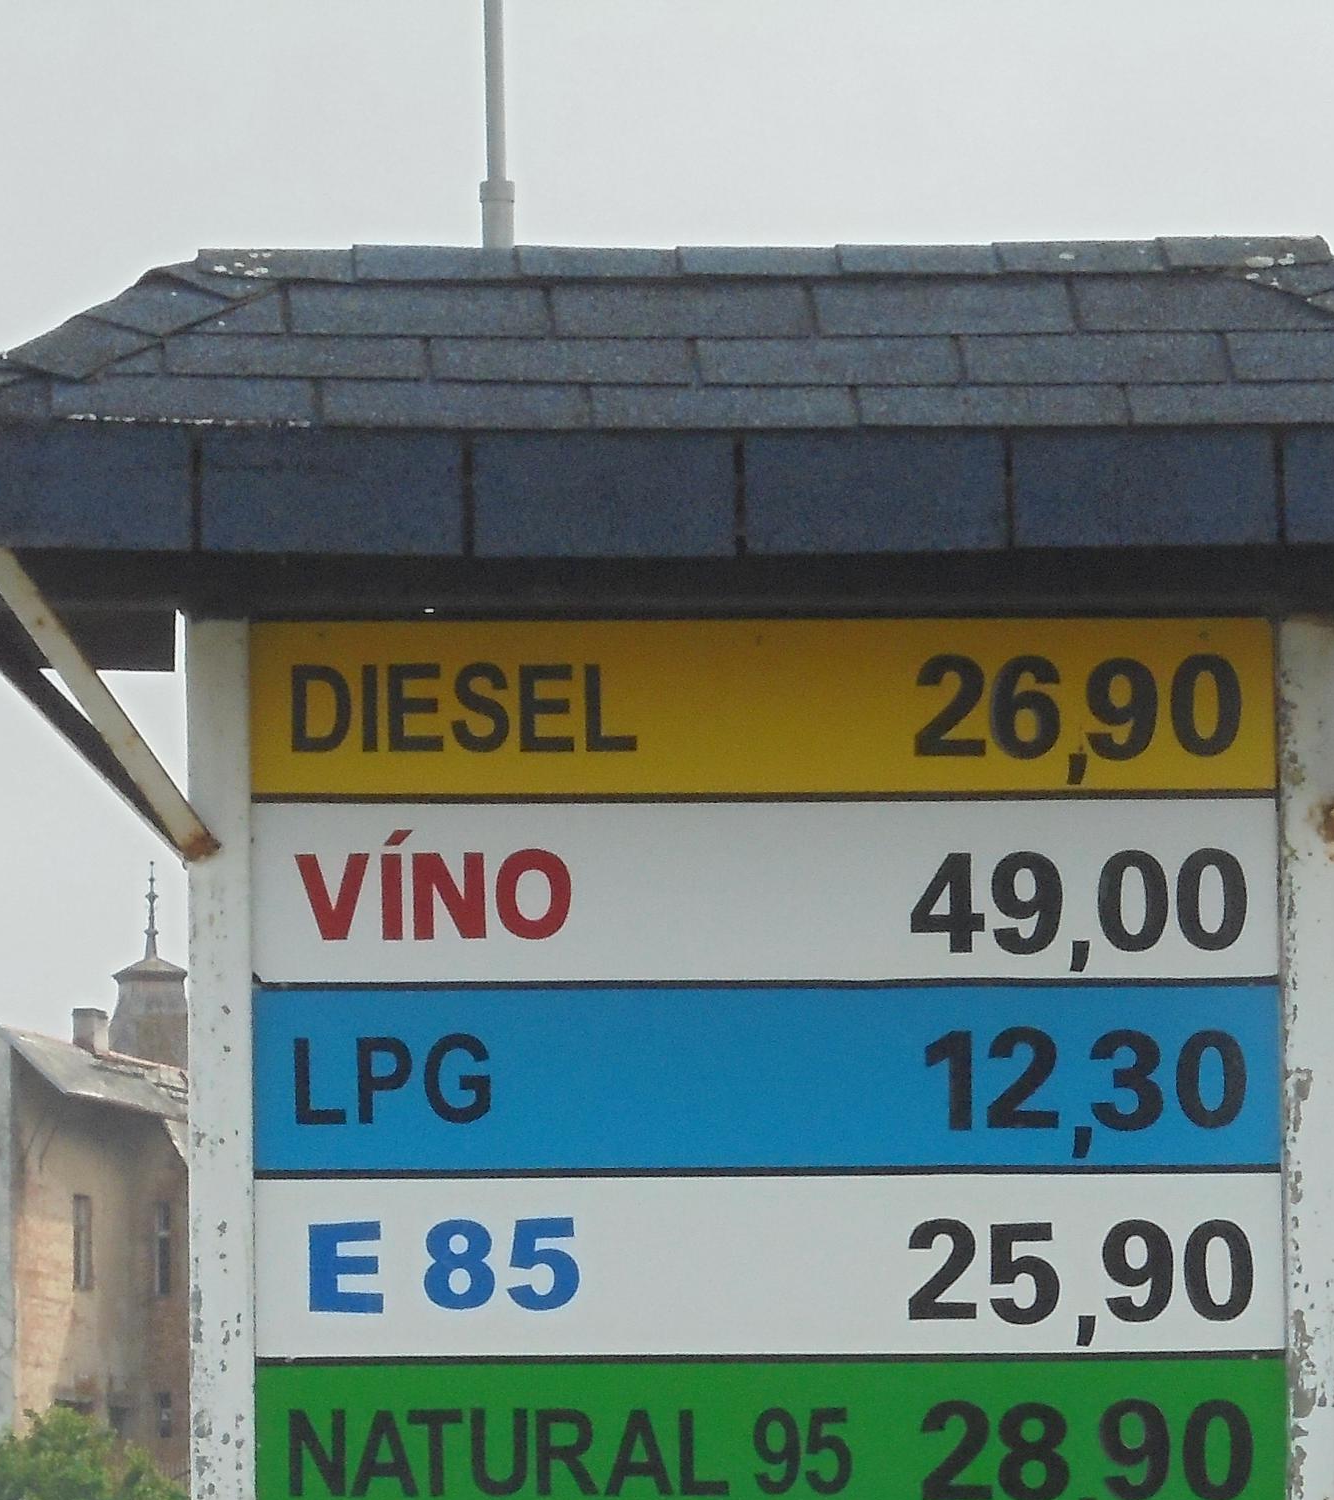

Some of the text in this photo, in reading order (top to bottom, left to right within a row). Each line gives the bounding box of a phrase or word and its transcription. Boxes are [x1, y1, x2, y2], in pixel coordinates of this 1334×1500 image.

[291, 653, 1242, 785] DIESEL 26,90
[294, 829, 1247, 973] VÍNO 49,00
[294, 1026, 1247, 1159] LPG 12,30
[308, 1217, 1254, 1347] E 85 25,90
[288, 1407, 730, 1498] NATURAL
[752, 1407, 854, 1496] 95
